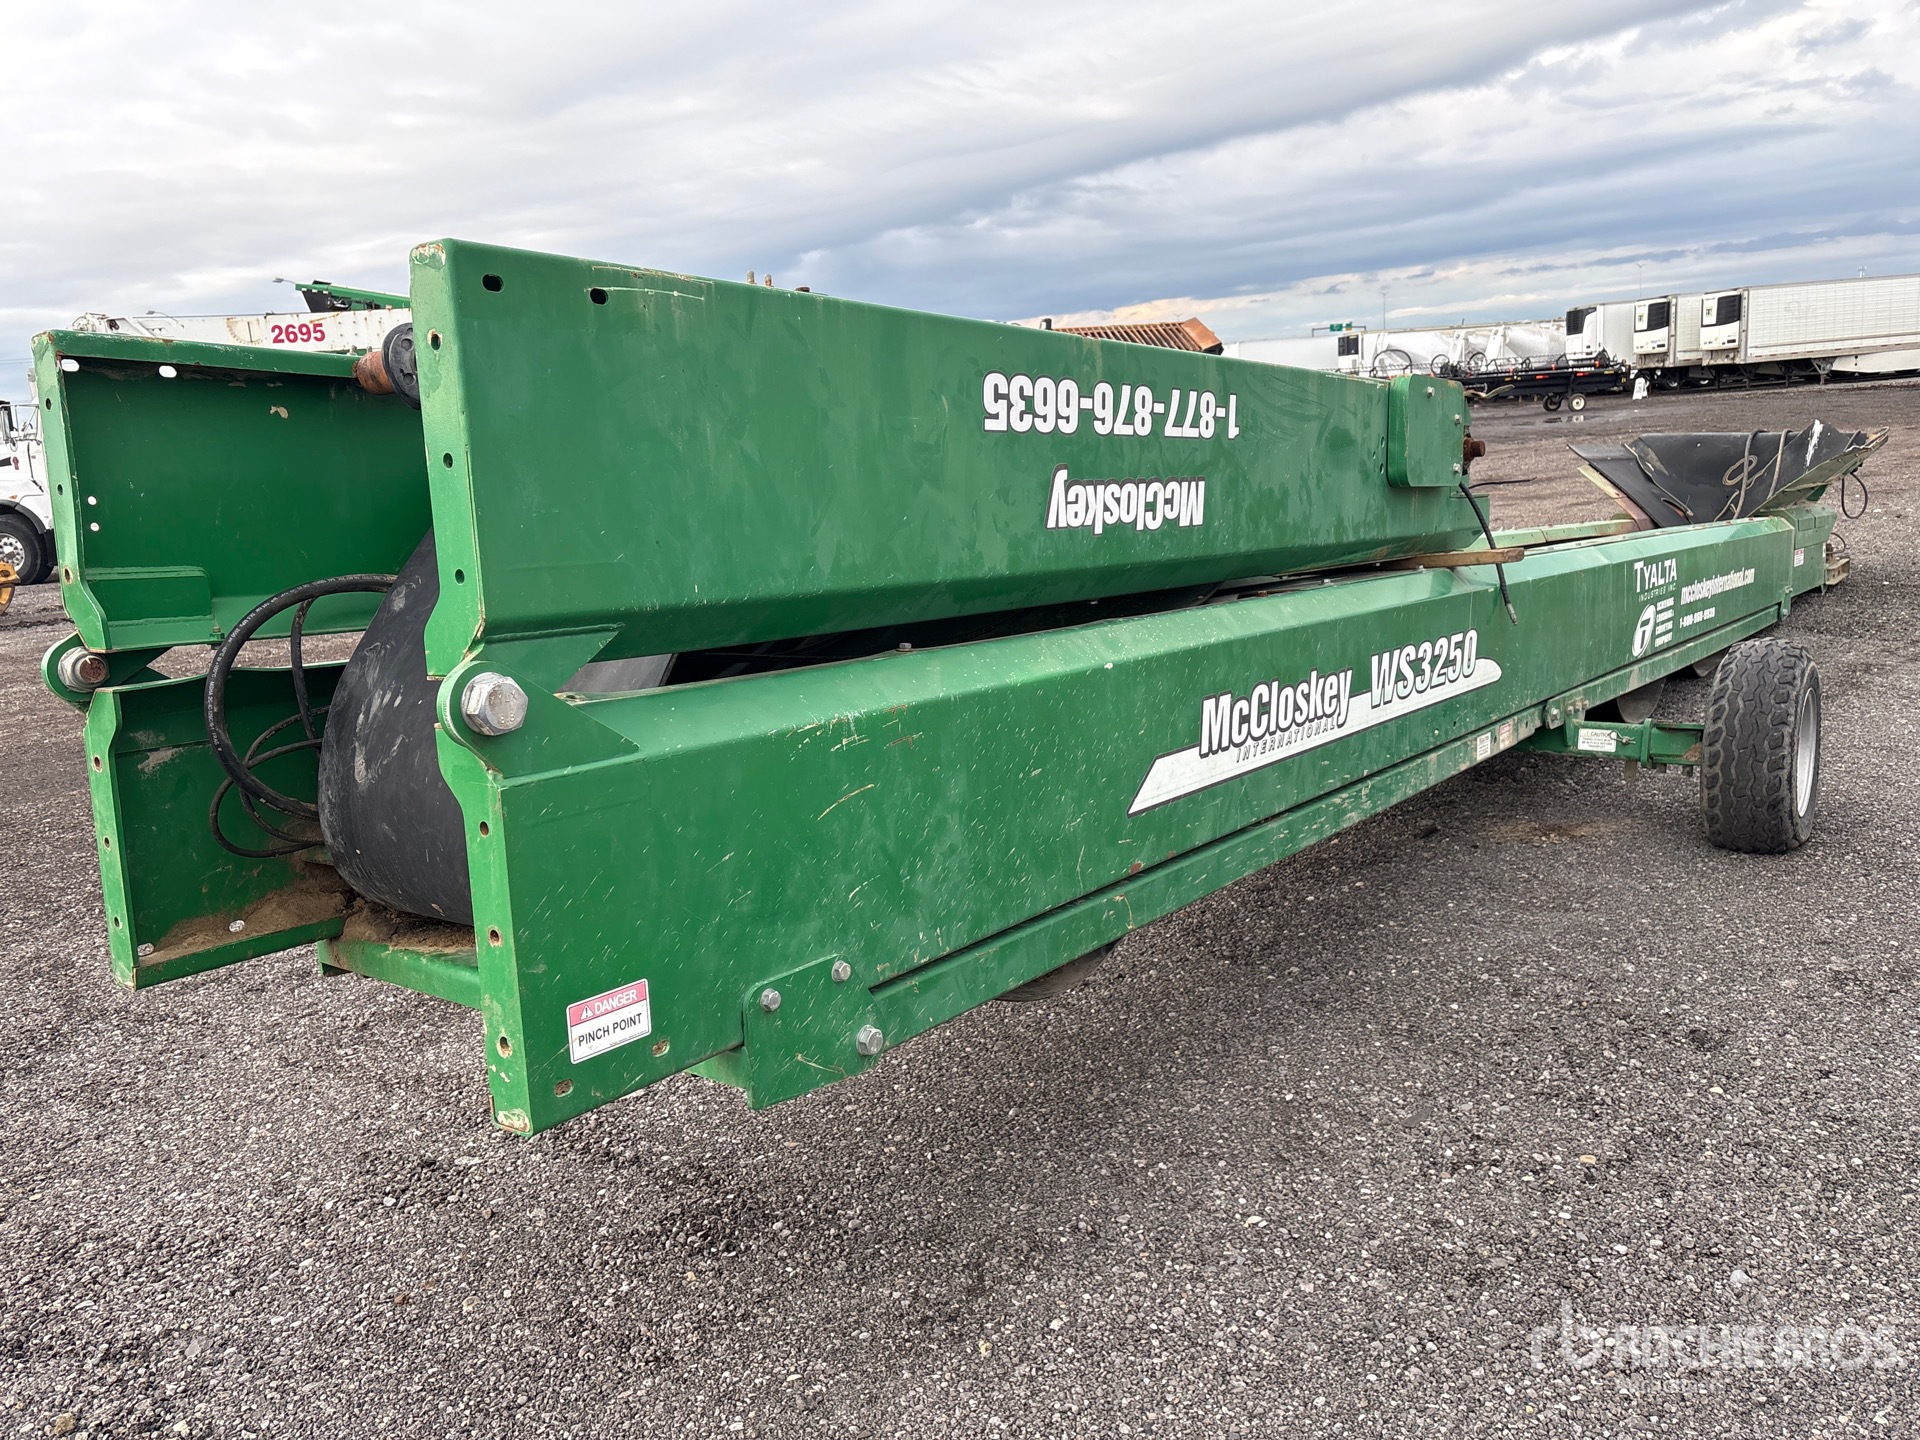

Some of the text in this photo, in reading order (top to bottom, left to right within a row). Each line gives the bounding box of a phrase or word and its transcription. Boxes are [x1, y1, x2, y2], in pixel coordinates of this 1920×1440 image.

[271, 322, 326, 344] 2695
[983, 370, 1241, 440] 1-877-876-6635
[1045, 464, 1206, 535] McCloskey
[1200, 627, 1478, 758] McCloskey WS3250
[1236, 715, 1336, 763] INTERNATIONAL
[594, 989, 638, 1015] DANGER
[578, 1025, 611, 1047] PINCH
[612, 1012, 643, 1034] POINT
